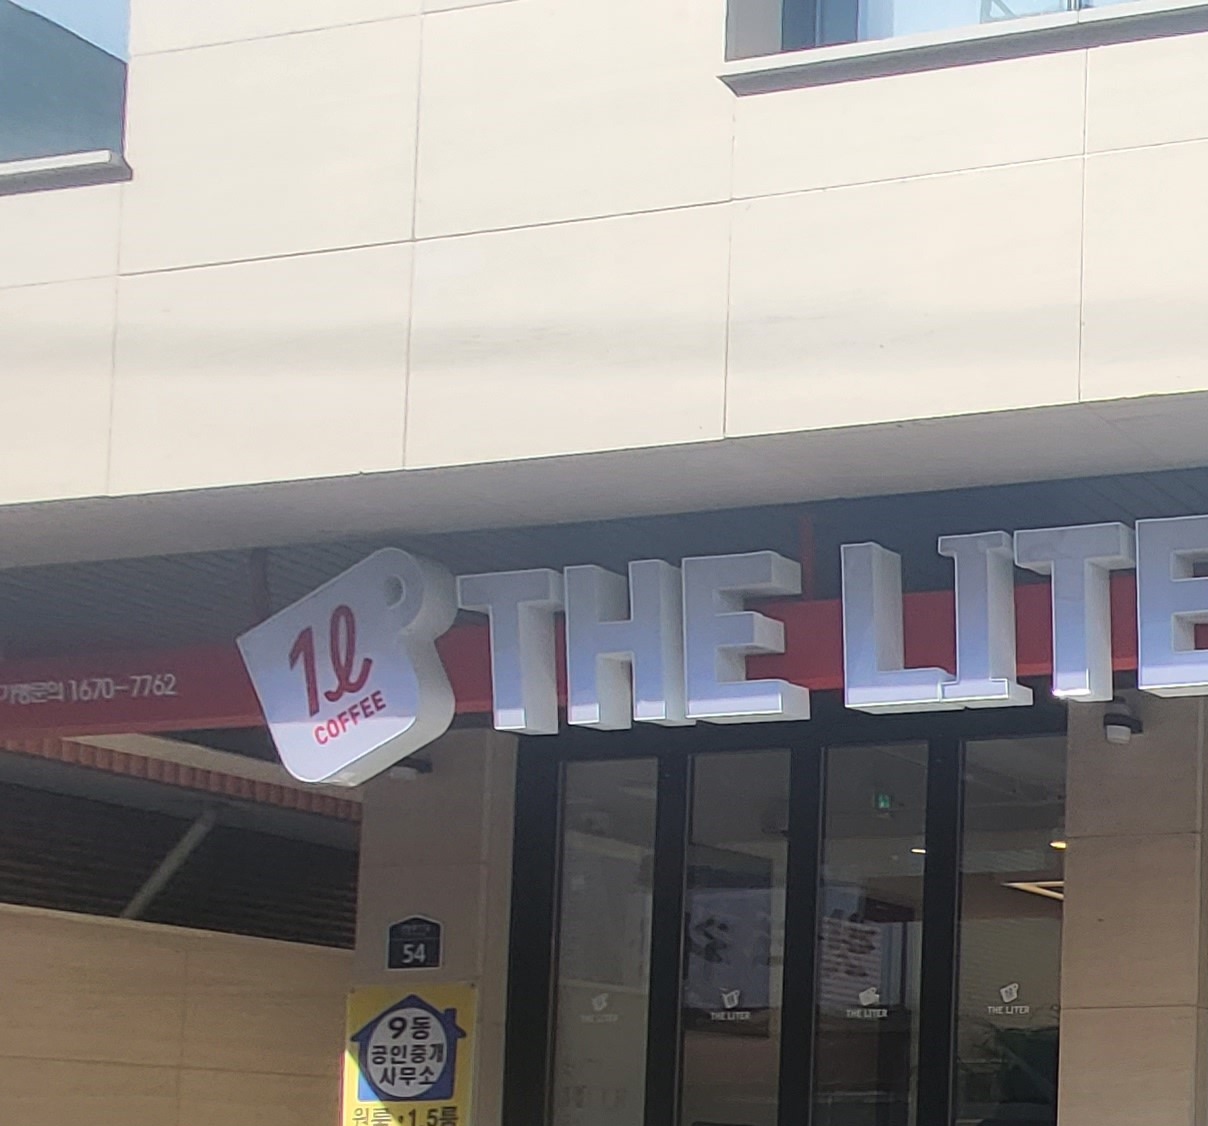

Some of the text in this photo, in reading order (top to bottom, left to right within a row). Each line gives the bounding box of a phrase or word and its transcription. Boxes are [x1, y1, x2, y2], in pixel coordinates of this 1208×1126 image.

[457, 551, 809, 735] THE
[68, 673, 178, 702] 1670-7762
[314, 690, 387, 745] COFFEE
[402, 943, 426, 964] 54
[388, 1016, 431, 1041] 9동
[371, 1043, 445, 1065] 공인중개
[379, 1066, 440, 1087] 사무소
